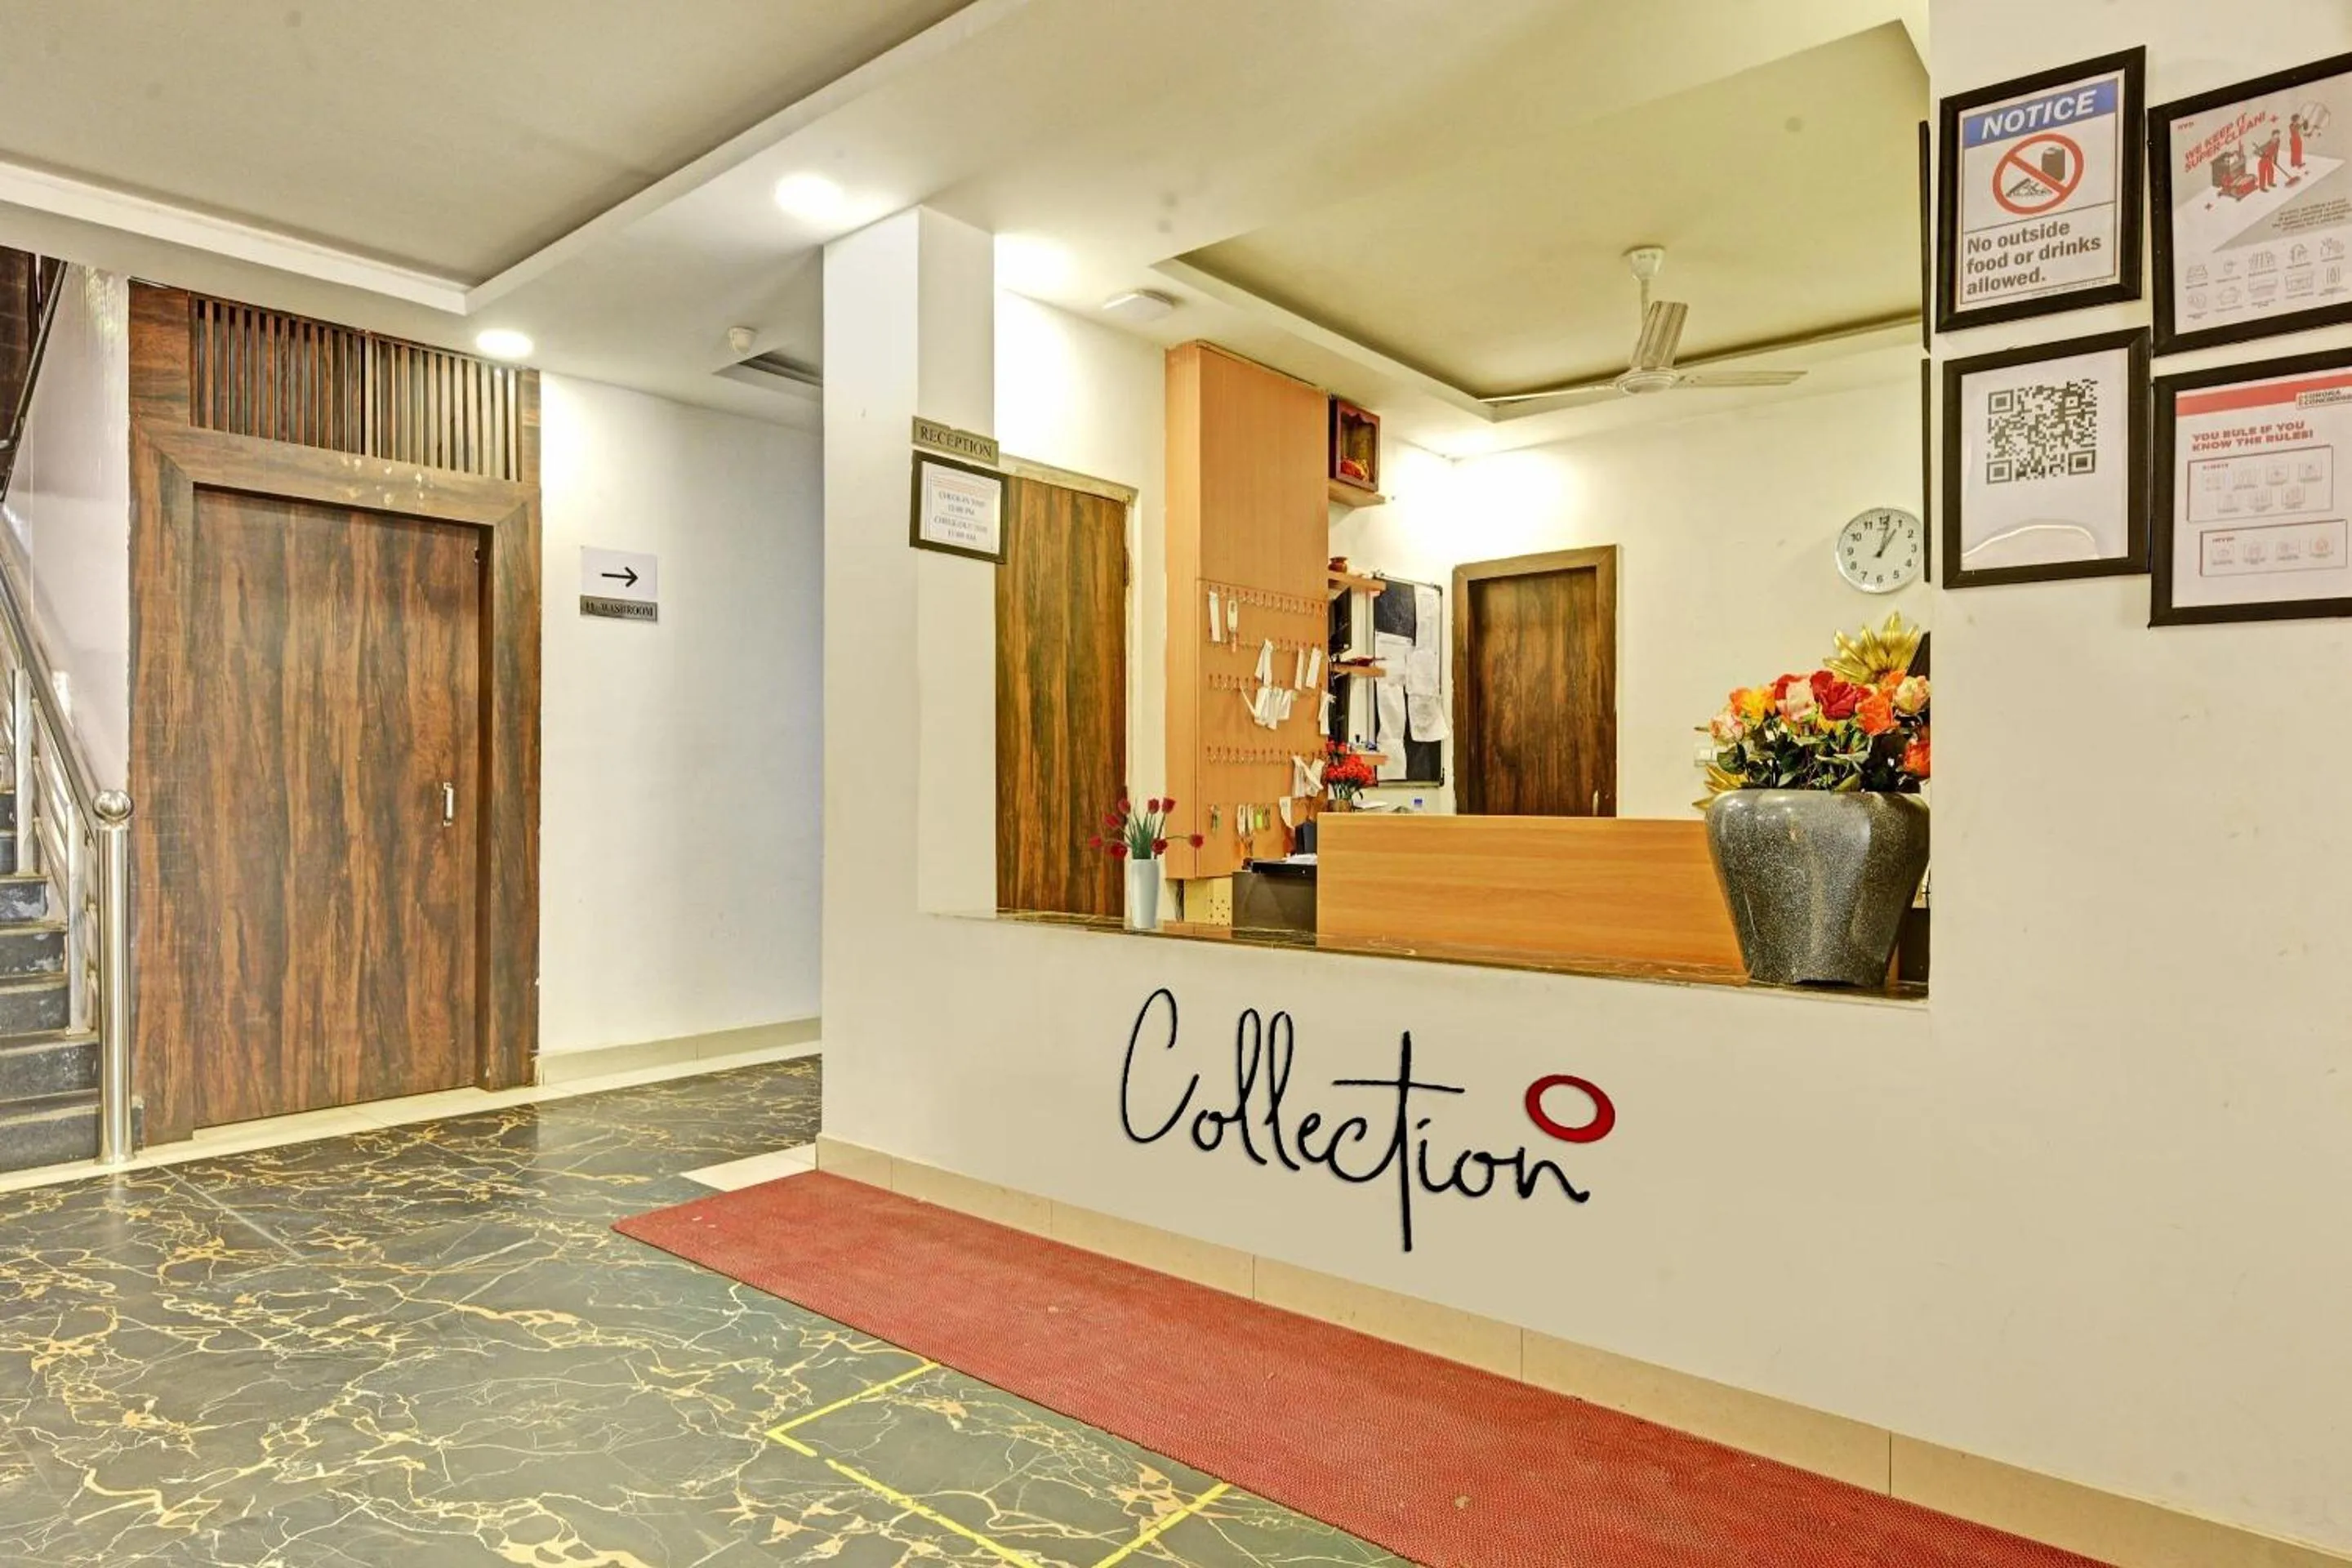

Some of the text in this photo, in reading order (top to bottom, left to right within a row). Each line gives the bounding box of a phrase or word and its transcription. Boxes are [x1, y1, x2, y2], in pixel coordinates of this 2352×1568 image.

[1981, 89, 2097, 140] NOTICE
[1967, 221, 2070, 254] No outside
[1967, 236, 2101, 274] food or drinks
[1967, 267, 2046, 295] allowed.
[920, 425, 991, 458] RECEPTION
[2193, 421, 2305, 442] YOU RULE IF YOU
[2193, 430, 2313, 452] KNOW THE RULES!
[1121, 987, 1591, 1253] Collection
